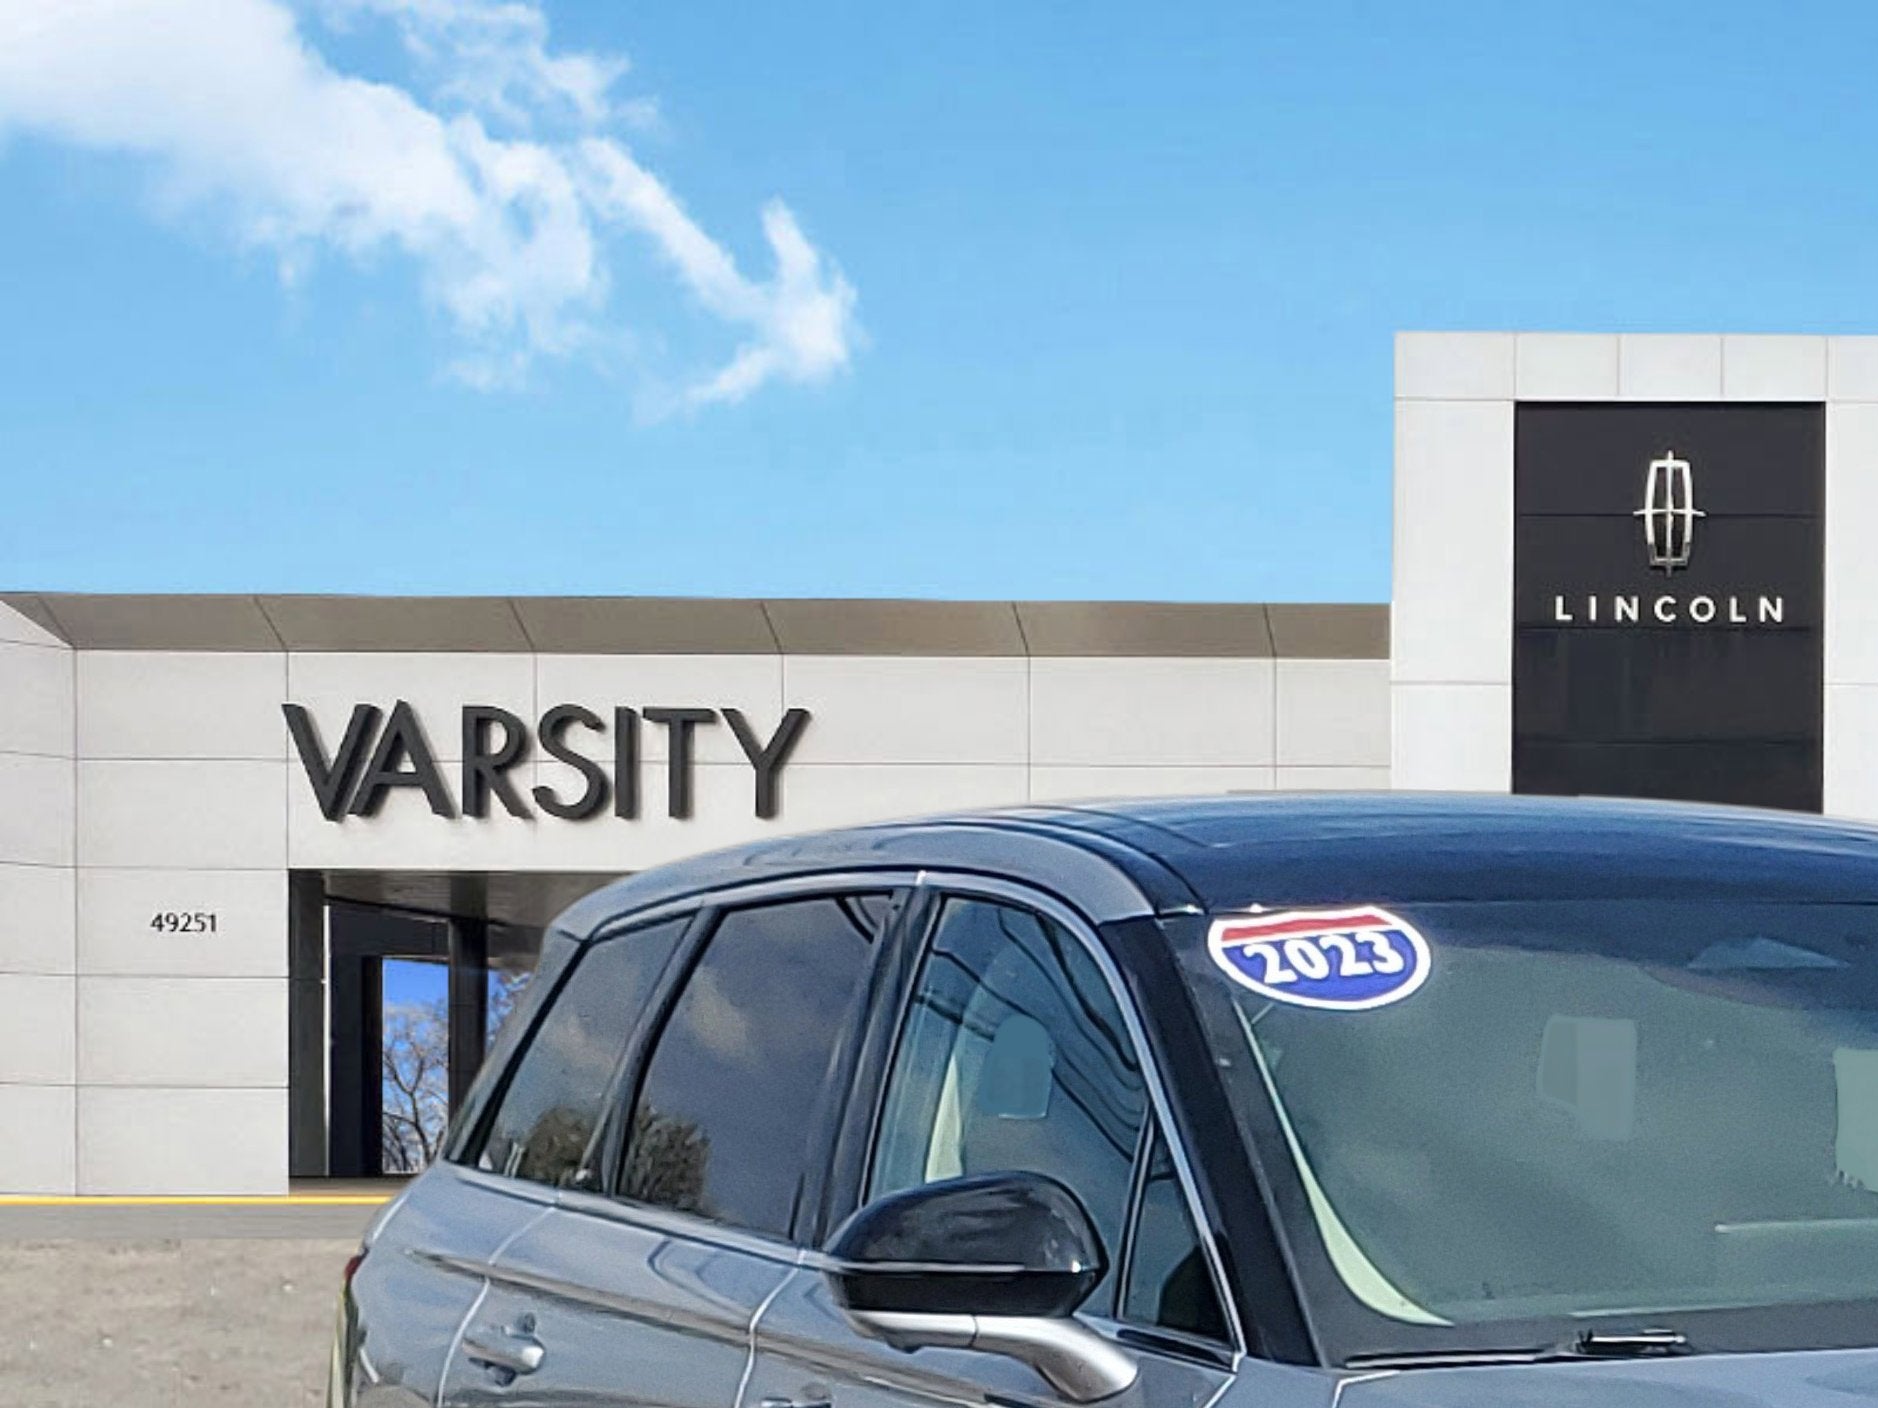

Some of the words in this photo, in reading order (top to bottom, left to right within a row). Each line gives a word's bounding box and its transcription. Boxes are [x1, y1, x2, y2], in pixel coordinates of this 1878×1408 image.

[1555, 596, 1784, 622] LINCOLN
[282, 699, 811, 822] VARSITY
[150, 912, 216, 932] 49251
[1243, 931, 1404, 983] 2023
